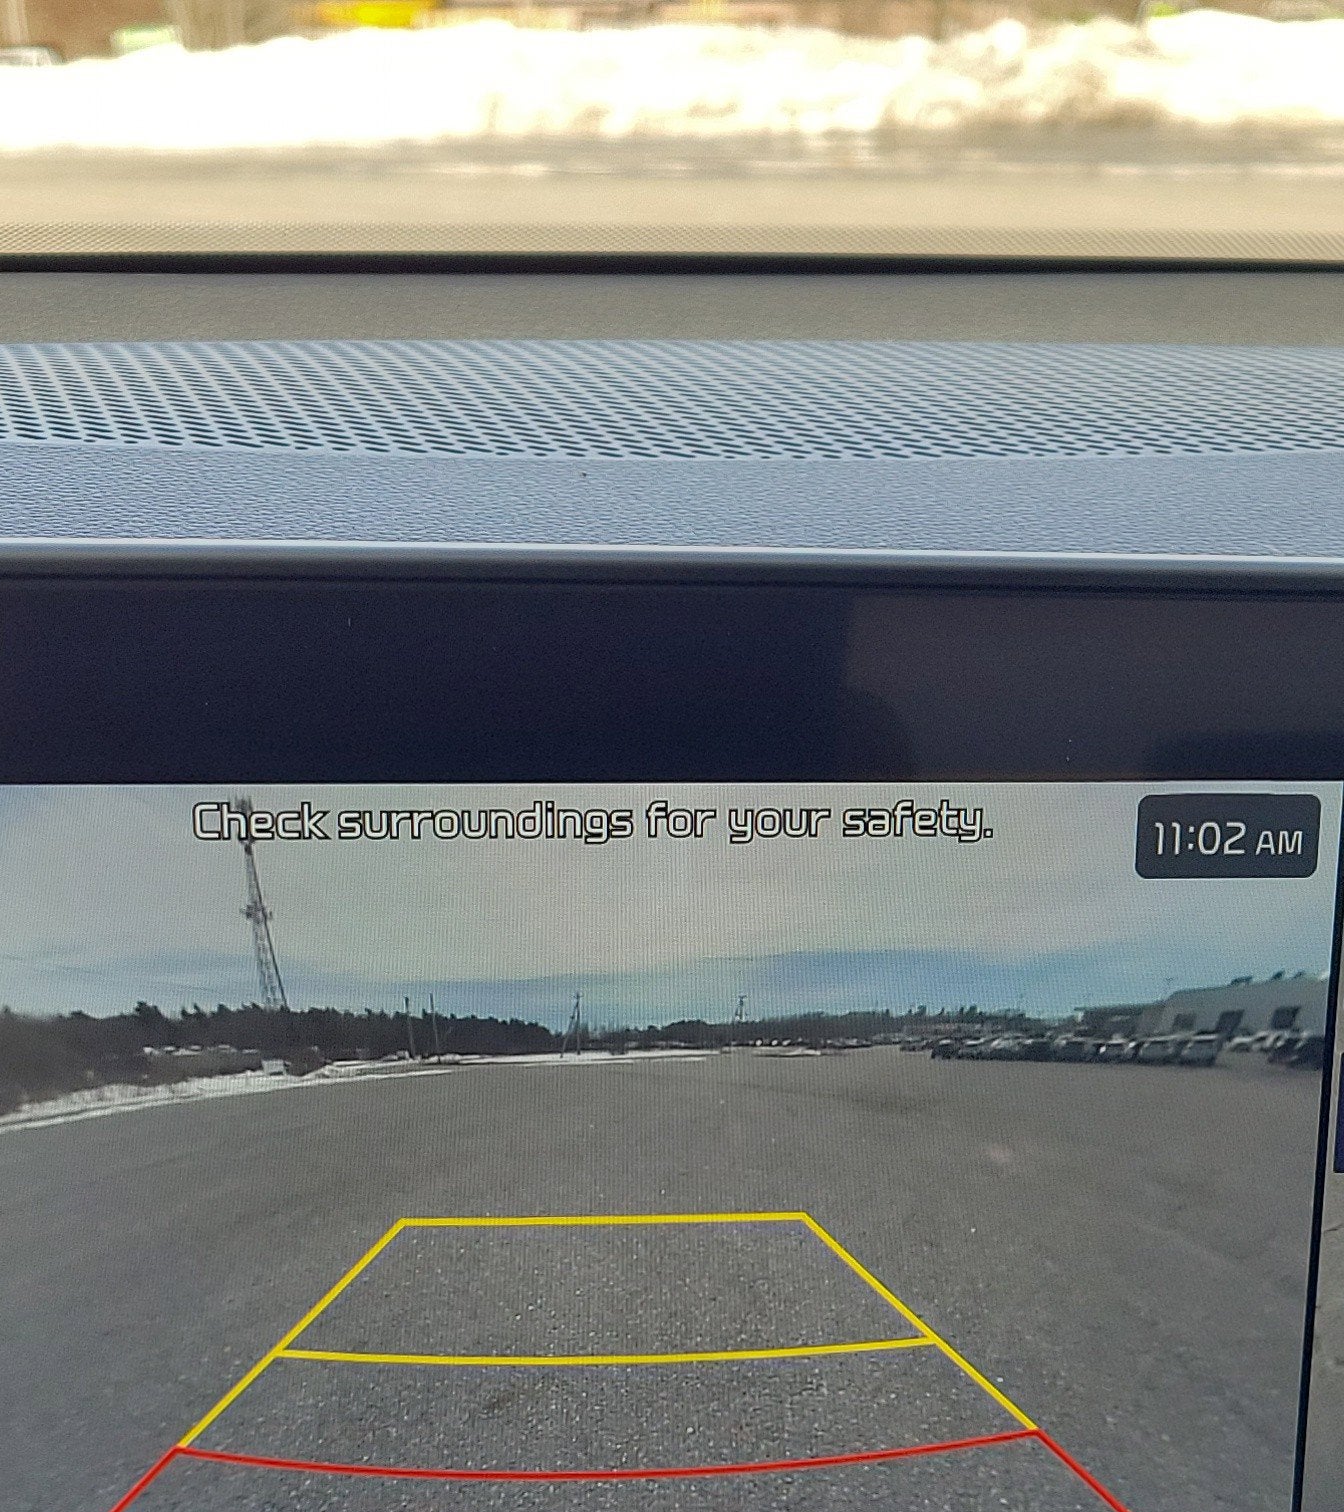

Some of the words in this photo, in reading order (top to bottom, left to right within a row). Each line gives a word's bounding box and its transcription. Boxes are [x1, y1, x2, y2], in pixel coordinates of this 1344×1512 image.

[192, 801, 331, 840] Check
[338, 801, 634, 845] surroundings
[646, 800, 717, 838] for
[728, 807, 832, 844] your
[842, 800, 994, 844] safety.
[1154, 821, 1247, 855] 11:02
[1255, 830, 1303, 855] AM
